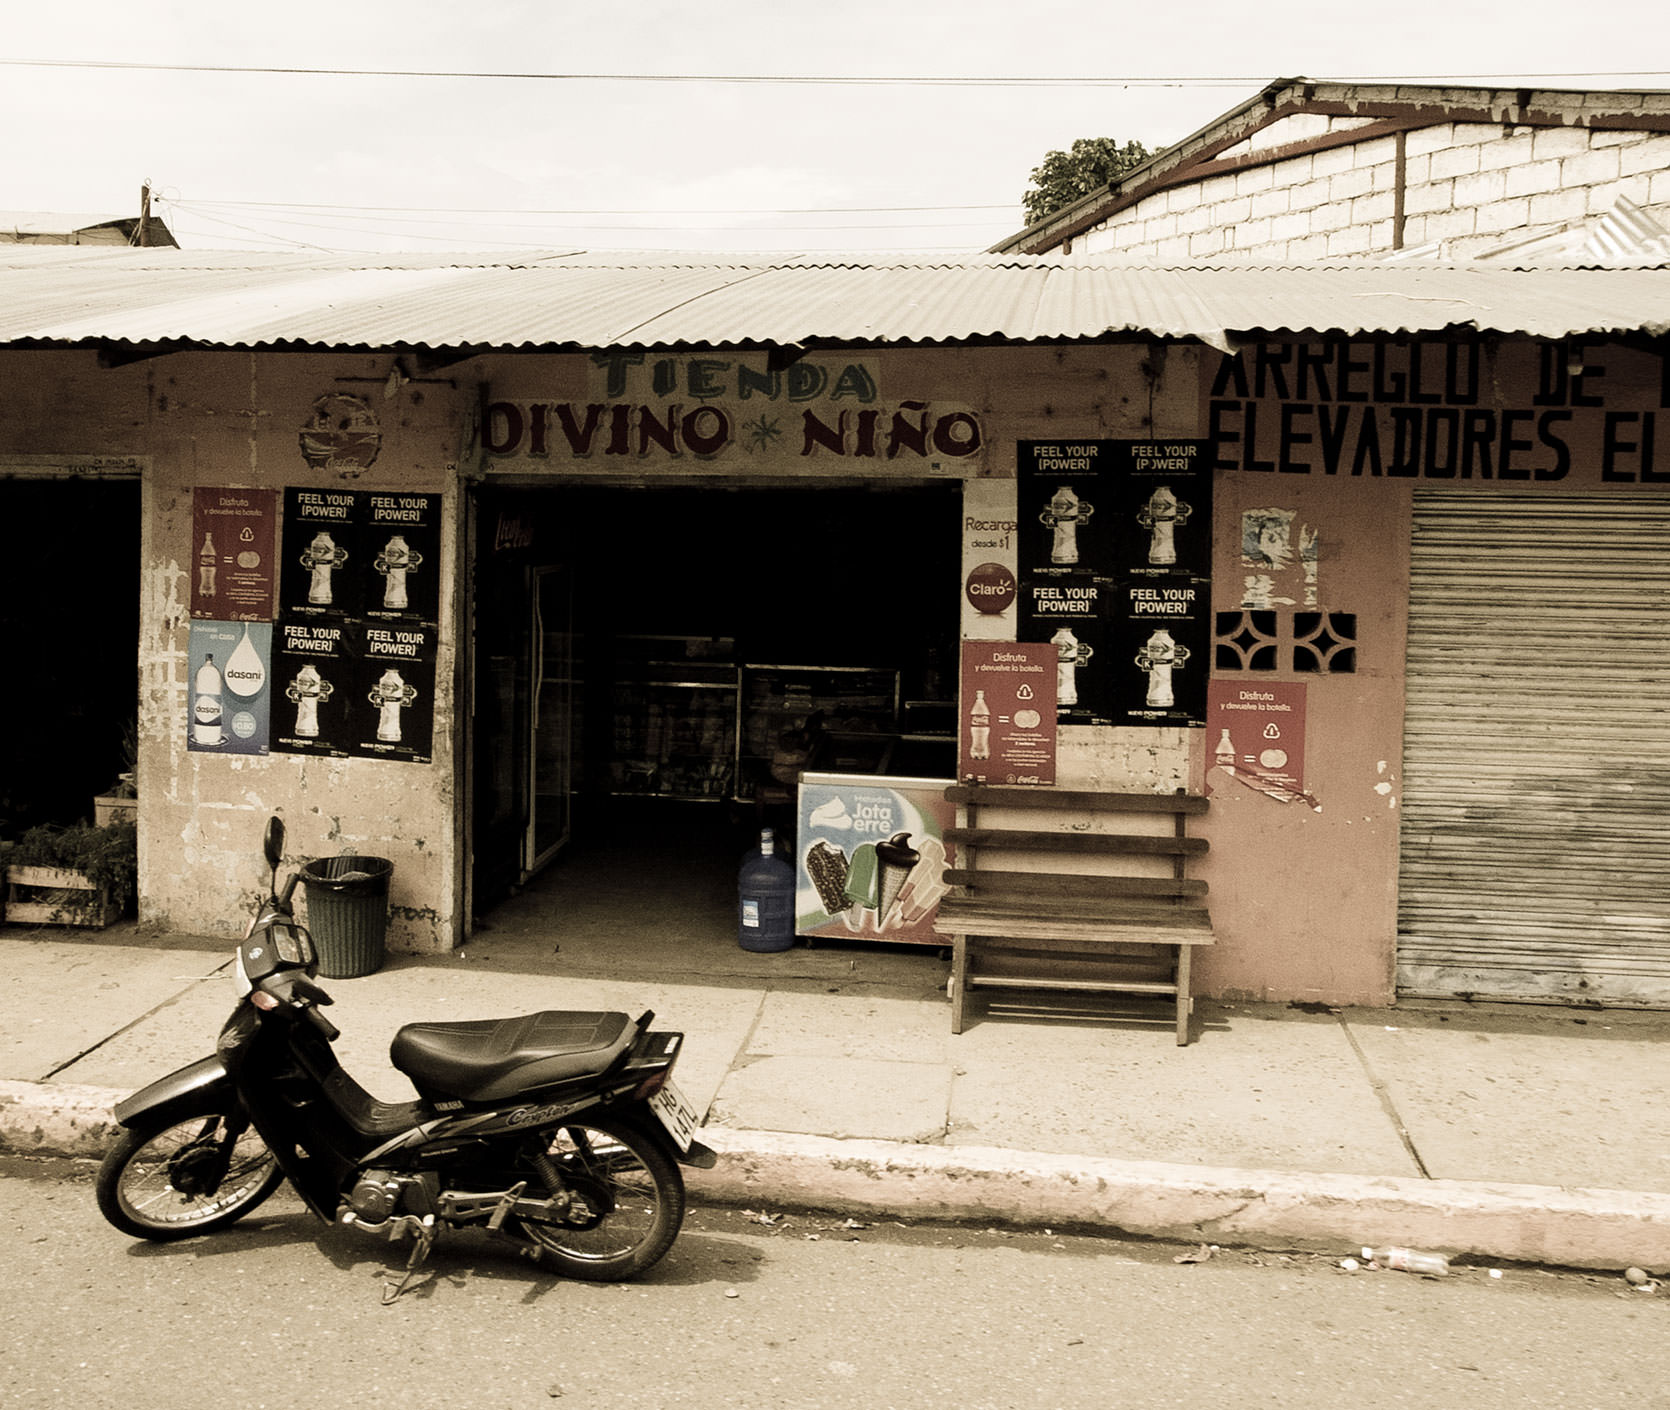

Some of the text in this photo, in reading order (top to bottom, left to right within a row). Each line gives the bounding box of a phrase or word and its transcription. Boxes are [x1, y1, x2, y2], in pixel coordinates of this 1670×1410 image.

[592, 353, 878, 401] TIENDA
[1210, 343, 1479, 405] ARREGLO
[1533, 343, 1606, 407] DE
[480, 401, 984, 458] DIVINO NIÑO
[1208, 400, 1572, 482] ELEVADORES
[1033, 446, 1098, 457] FEEL YOUR
[1131, 446, 1197, 457] FEEL YOUR
[298, 492, 354, 507] FEEL YOUR
[370, 497, 428, 510] FEEL YOUR
[966, 517, 1018, 534] Recarga
[972, 535, 1010, 550] desde $1
[969, 583, 1005, 596] Claro
[1033, 588, 1098, 600] FEEL YOUR
[1130, 589, 1195, 602] FEEL YOUR
[284, 626, 341, 640] FEEL YOUR
[366, 630, 424, 644] FEEL YOUR
[993, 652, 1027, 662] Disfruta
[980, 663, 1010, 672] devuelve
[1011, 663, 1018, 672] la
[227, 669, 261, 680] dasani
[1239, 691, 1274, 701] Disfruta
[196, 705, 220, 714] dasani
[1226, 702, 1257, 711] devuelve
[1258, 703, 1265, 711] la
[851, 803, 891, 819] Jota
[854, 819, 891, 834] erre
[434, 1100, 465, 1112] YAMAHA
